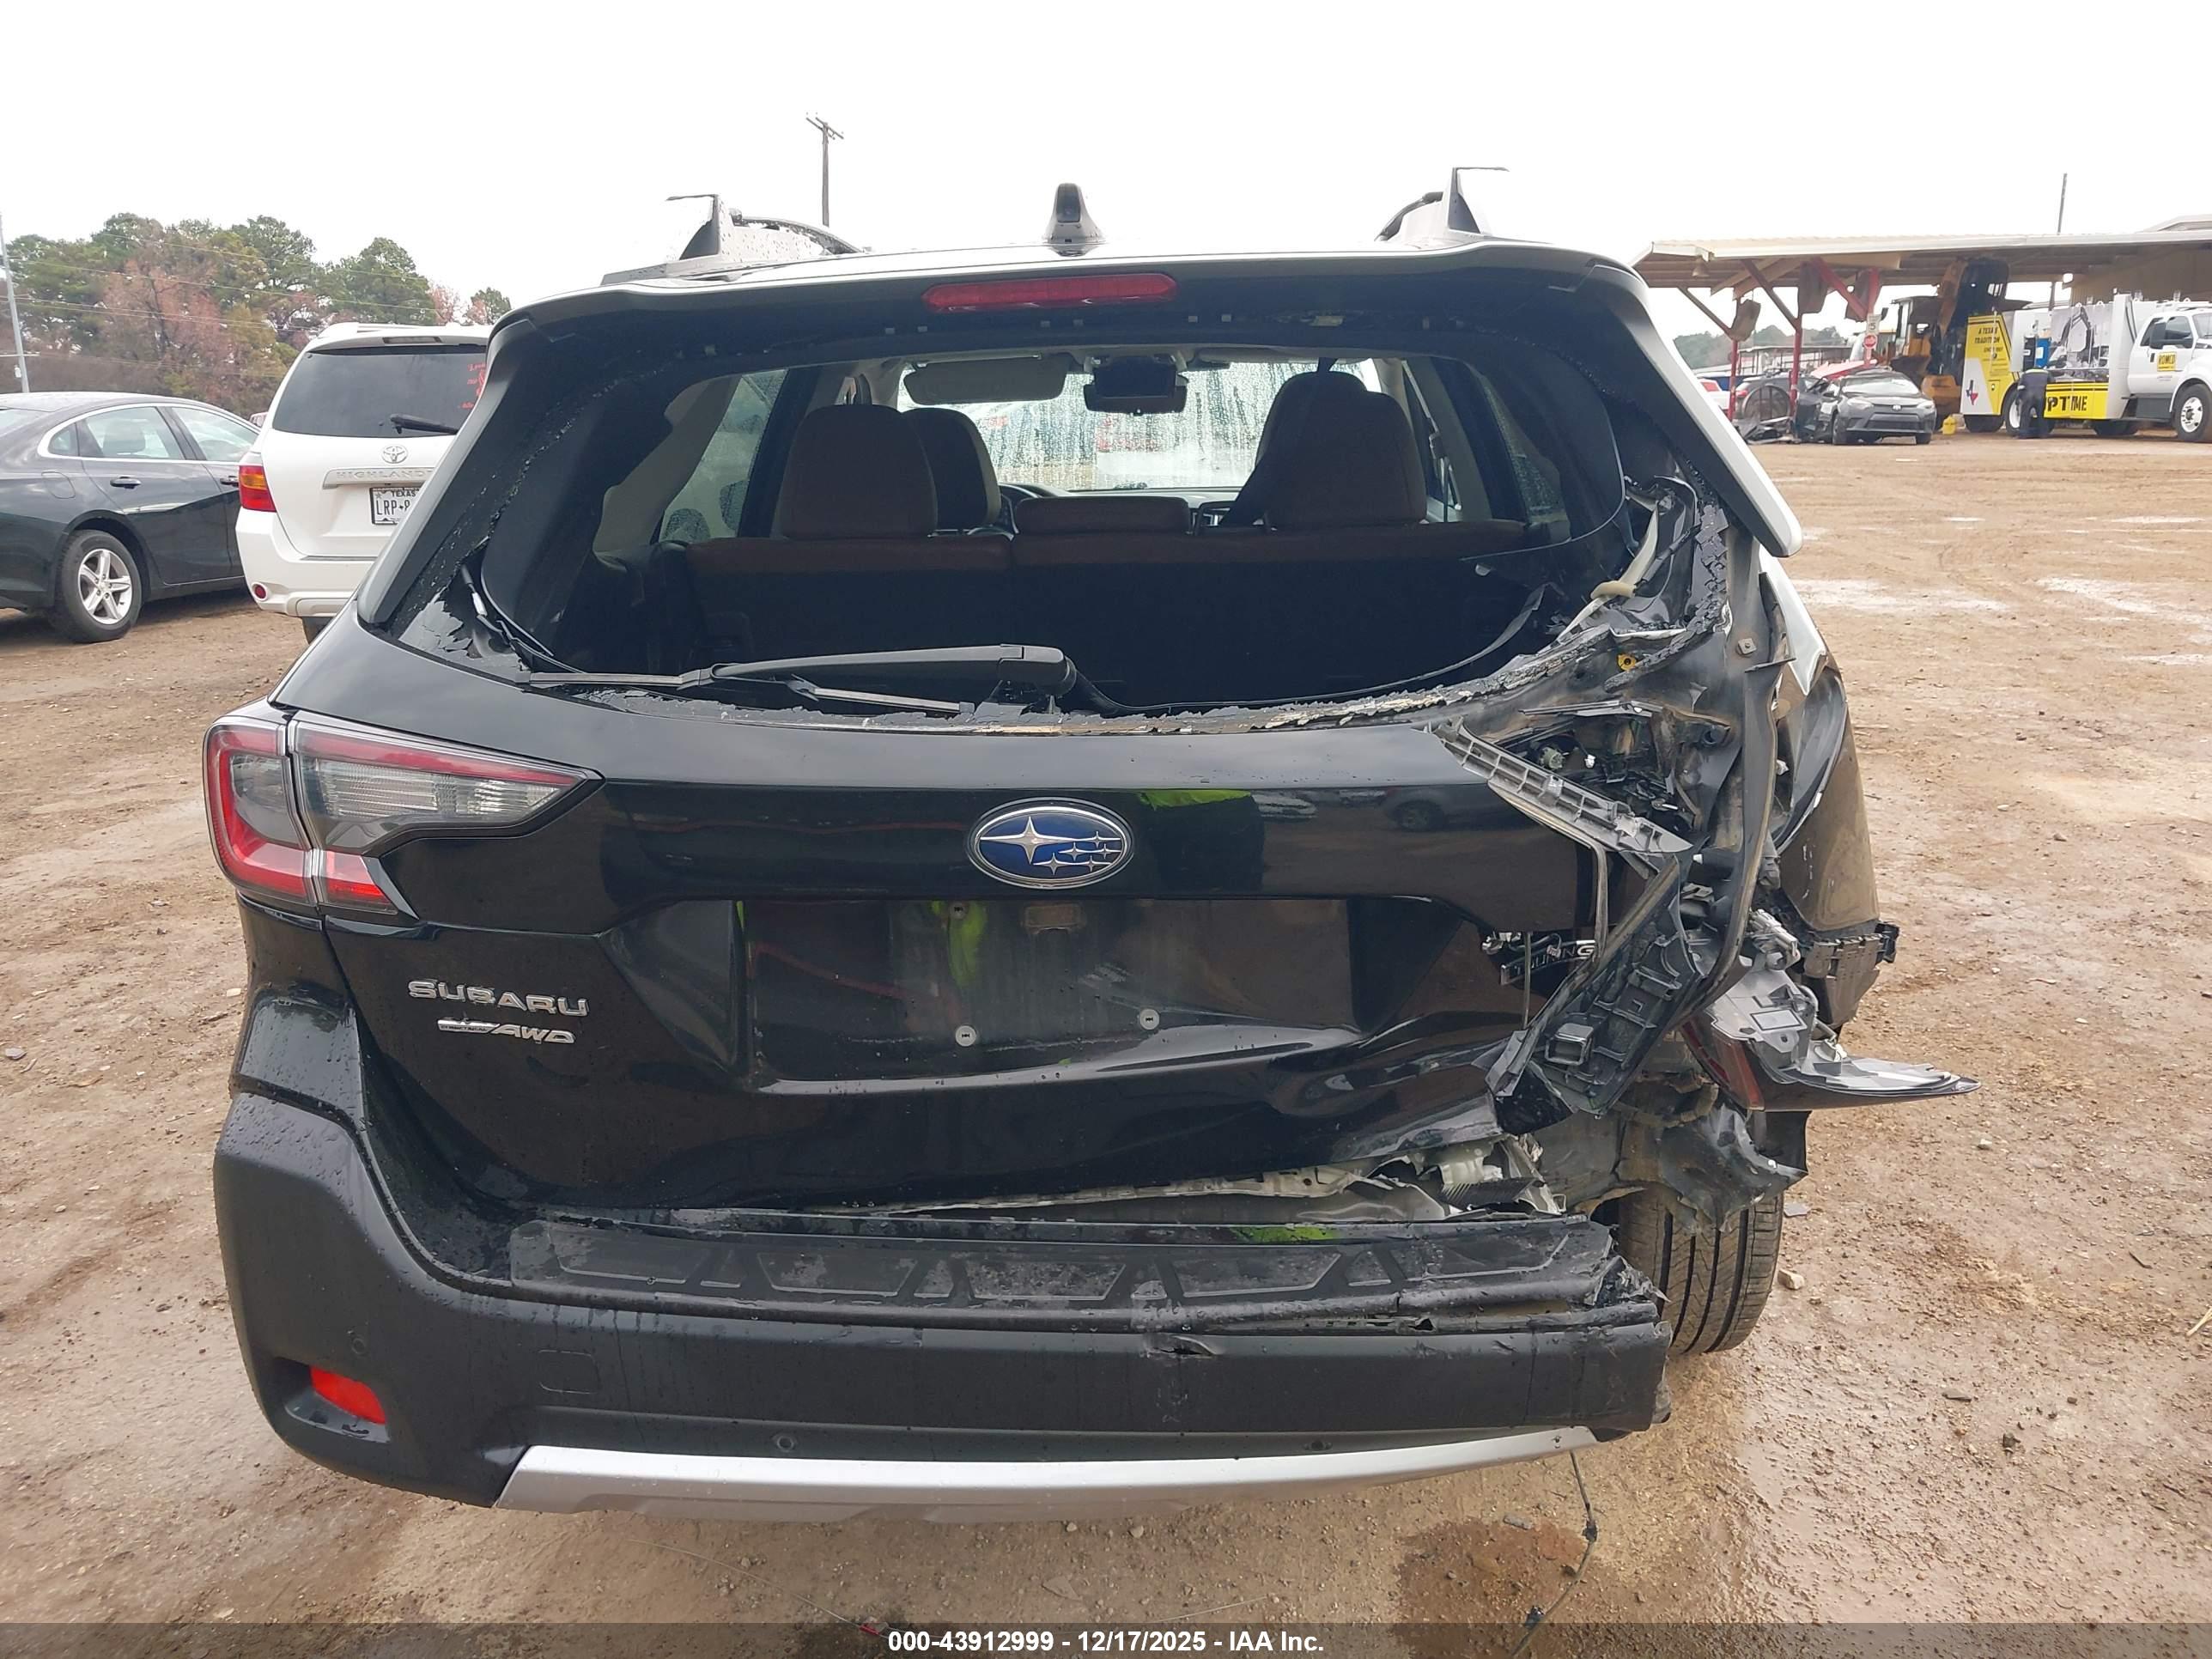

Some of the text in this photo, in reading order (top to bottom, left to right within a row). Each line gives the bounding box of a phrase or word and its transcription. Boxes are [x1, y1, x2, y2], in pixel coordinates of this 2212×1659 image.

[1975, 336, 2001, 344] TRADITON
[392, 489, 416, 498] TEXAS
[408, 978, 590, 1017] SUBARU
[490, 1024, 577, 1044] AWD
